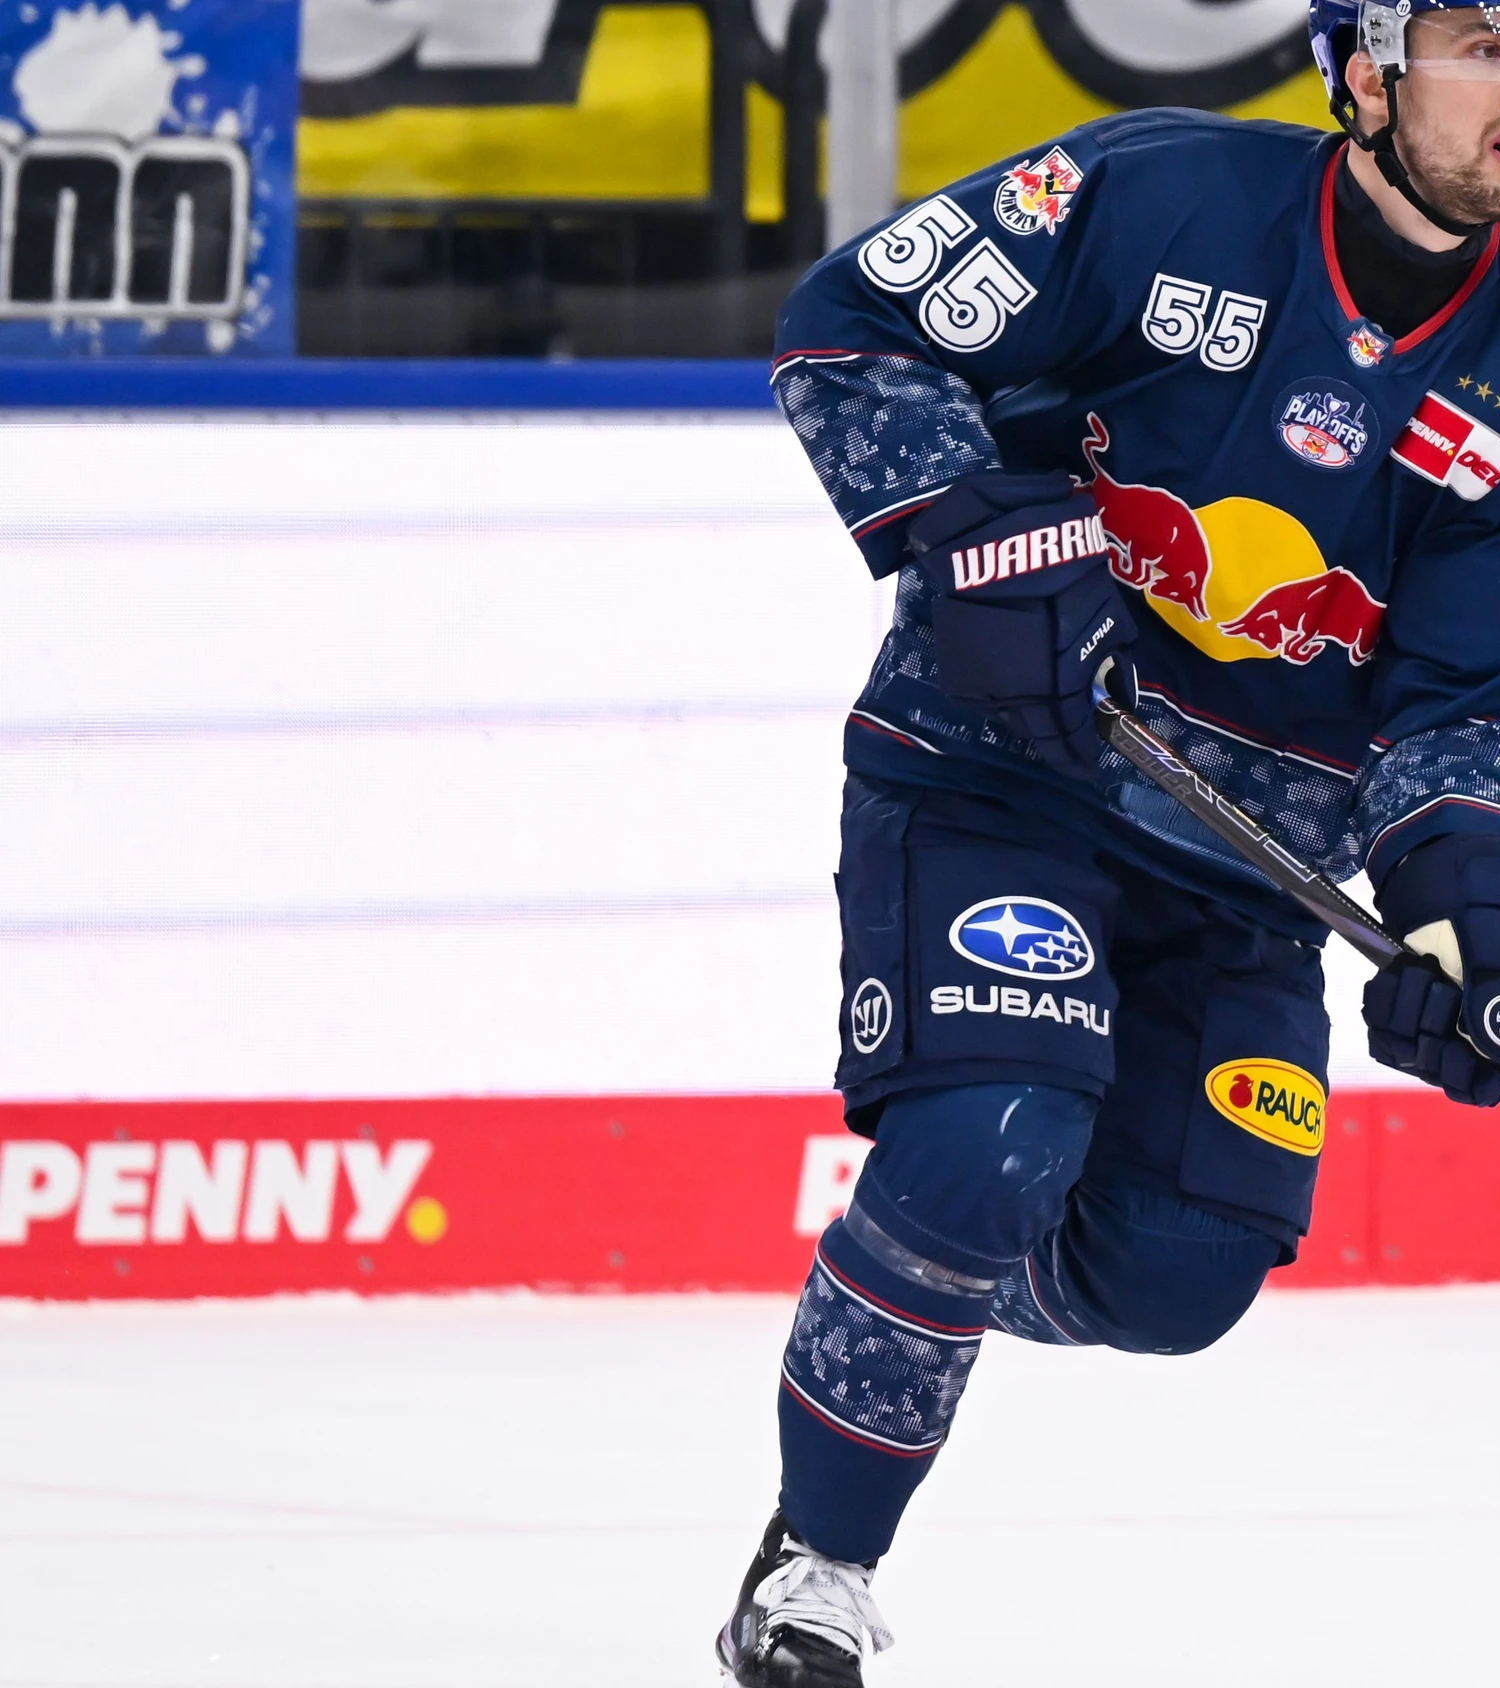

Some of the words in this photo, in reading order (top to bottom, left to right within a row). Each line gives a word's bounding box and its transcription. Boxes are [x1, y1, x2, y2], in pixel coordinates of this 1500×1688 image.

[858, 194, 1038, 352] 55
[1142, 273, 1267, 372] 55
[951, 515, 1108, 592] WARRIO
[1080, 616, 1115, 662] ALPHA
[930, 985, 1110, 1036] SUBARU
[1255, 1080, 1321, 1140] RAUCH
